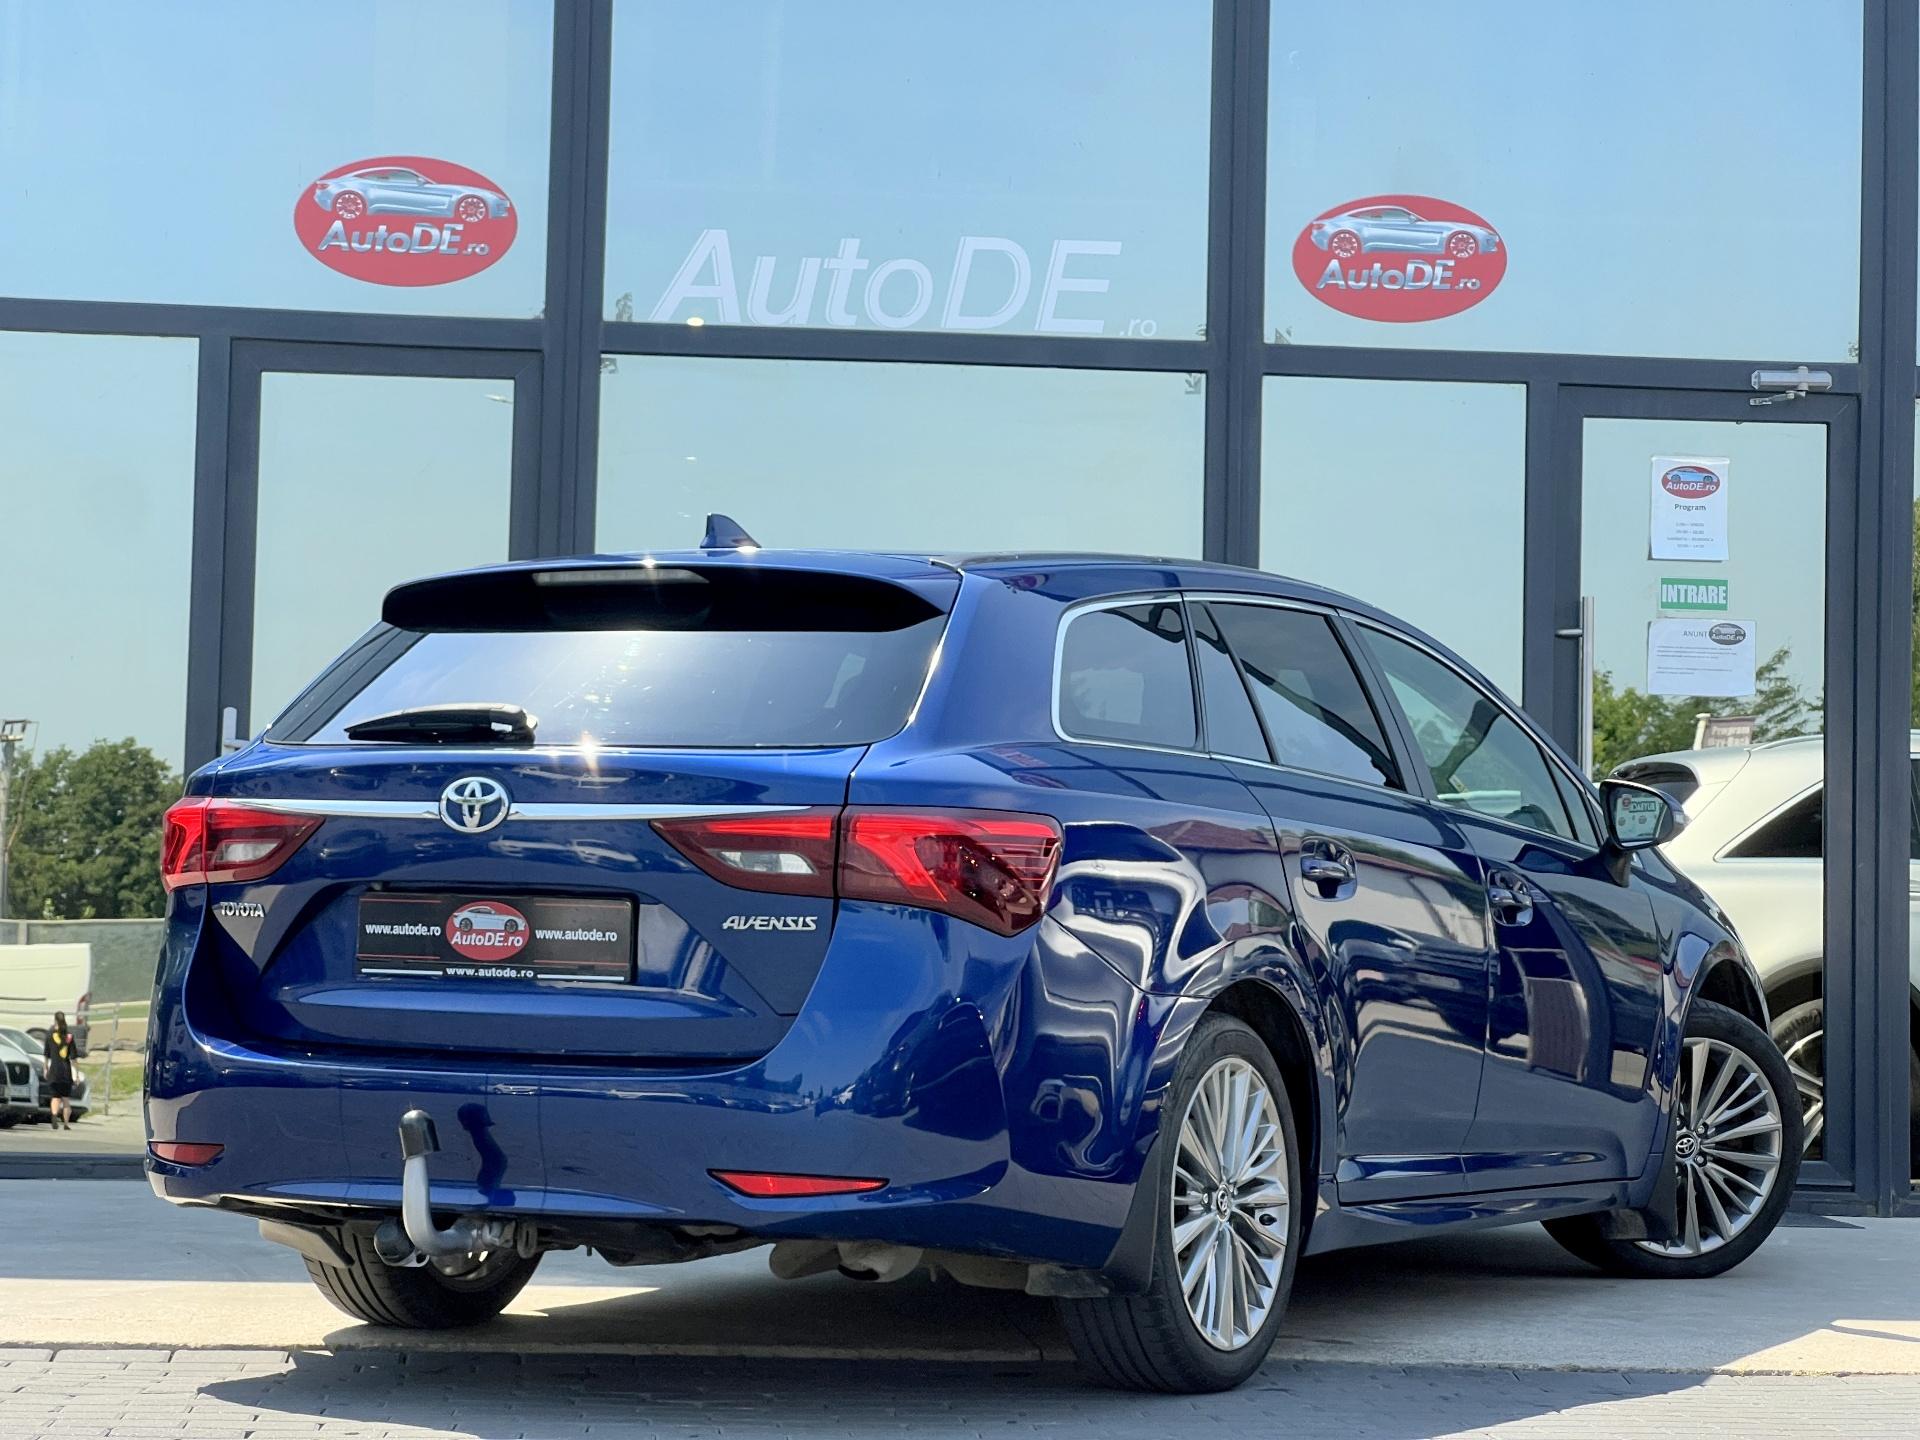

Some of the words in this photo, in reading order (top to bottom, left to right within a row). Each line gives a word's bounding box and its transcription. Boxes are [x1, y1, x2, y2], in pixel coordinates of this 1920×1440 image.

[1665, 482, 1717, 492] AutoDE.ro
[1674, 503, 1707, 511] Program
[1661, 584, 1727, 604] INTRARE
[220, 901, 265, 917] TOYOTA
[365, 922, 441, 937] www.autode.ro
[722, 915, 818, 931] AVENSIS
[451, 931, 523, 947] AutoDE.ro
[535, 928, 618, 942] www.autode.ro
[446, 967, 534, 978] www.autode.ro
